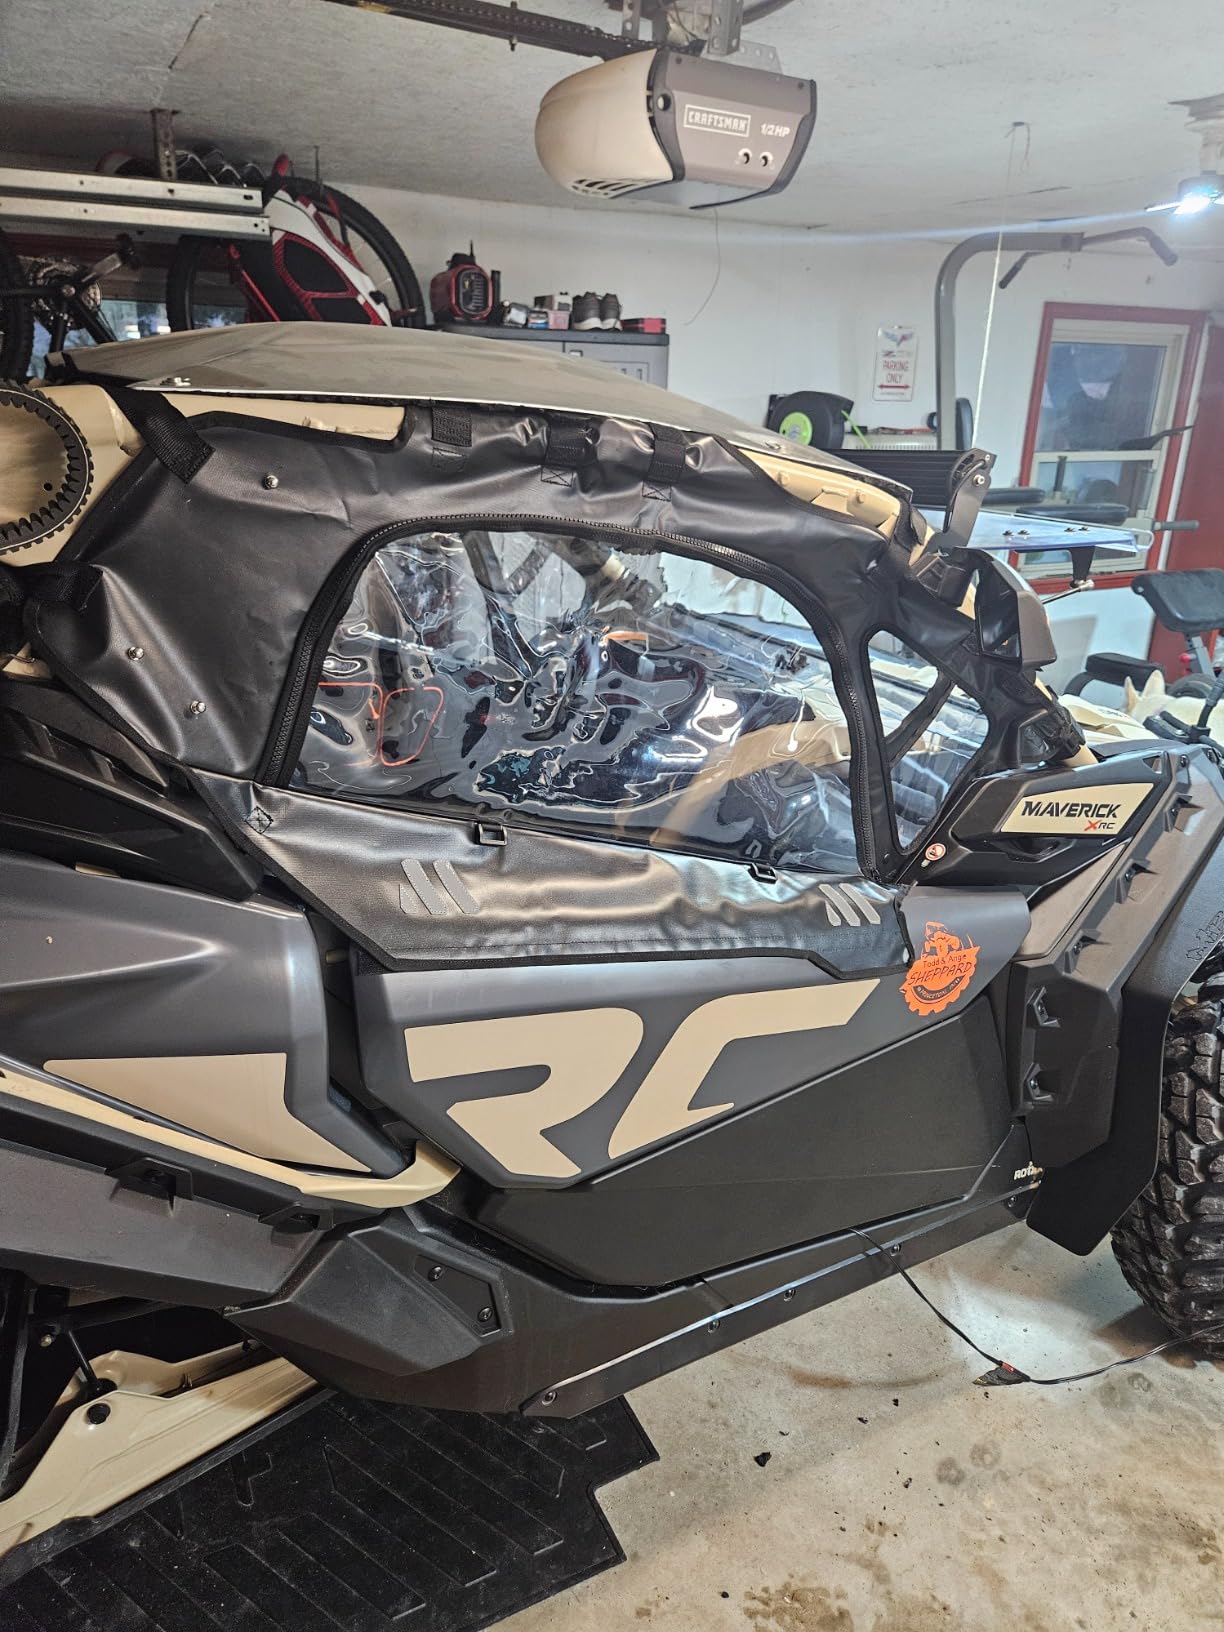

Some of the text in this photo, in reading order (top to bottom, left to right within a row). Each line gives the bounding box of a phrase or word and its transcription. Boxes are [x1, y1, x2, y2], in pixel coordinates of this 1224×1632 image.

[688, 111, 748, 131] CRAFTSMAN
[883, 360, 909, 371] PARKING
[886, 373, 903, 383] ONLY
[1021, 801, 1121, 818] MAVERICK
[908, 962, 972, 985] SHEPPARD
